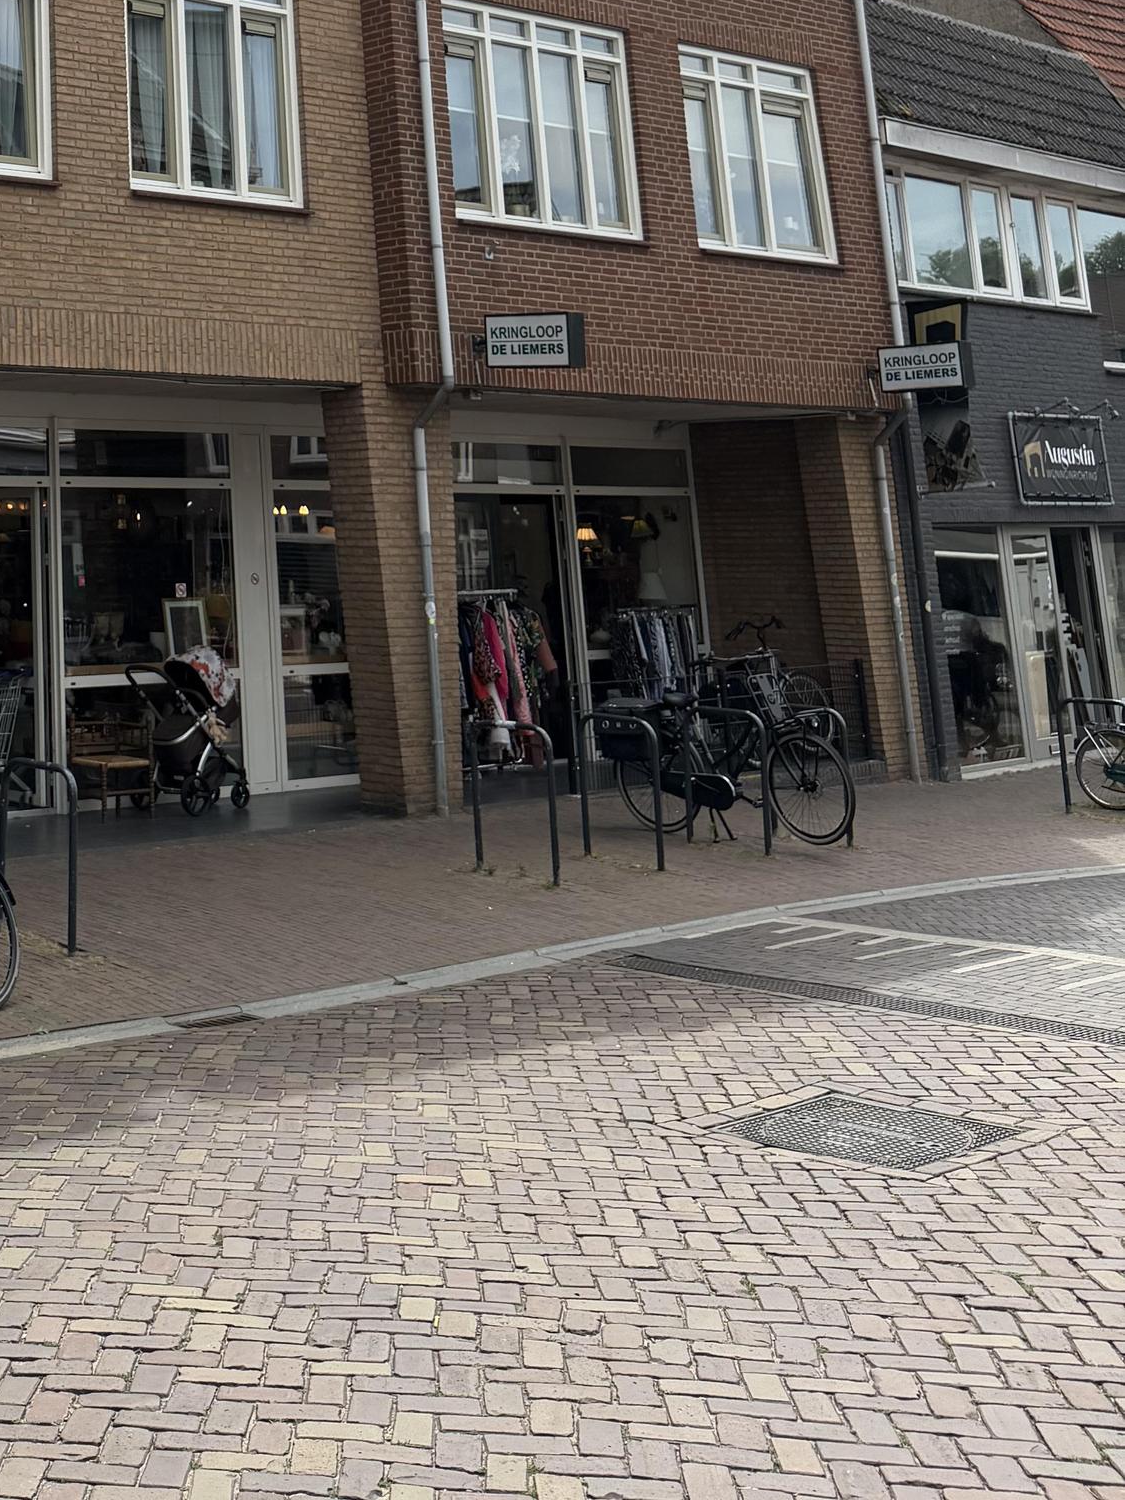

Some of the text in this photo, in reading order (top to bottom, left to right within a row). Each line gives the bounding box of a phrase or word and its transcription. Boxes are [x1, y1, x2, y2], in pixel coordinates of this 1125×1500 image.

[490, 325, 564, 339] KRINGLOOP
[491, 343, 565, 355] DE LIEMERS
[883, 352, 957, 368] KRINGLOOP
[885, 367, 958, 381] DE LIEMERS
[1044, 440, 1096, 470] Augustin
